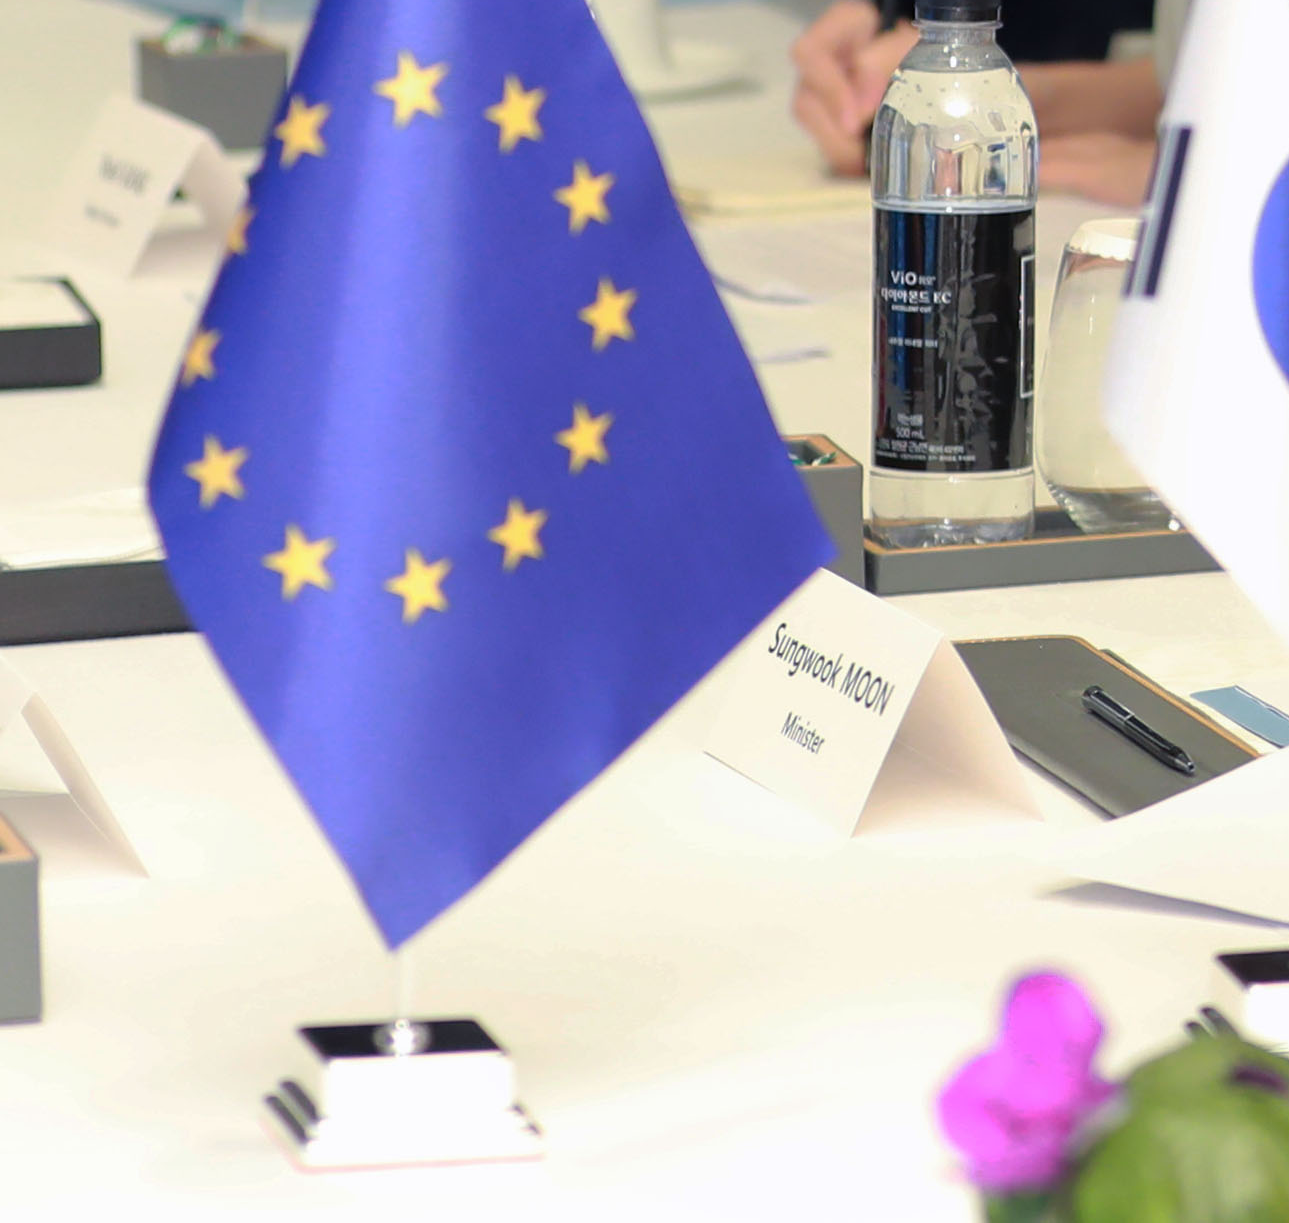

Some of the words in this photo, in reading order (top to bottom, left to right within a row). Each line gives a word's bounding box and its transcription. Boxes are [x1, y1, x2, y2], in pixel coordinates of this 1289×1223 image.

[891, 270, 917, 286] ViO
[881, 287, 930, 305] 다이아몬드
[933, 290, 952, 306] EC
[768, 623, 844, 688] Sungwook
[839, 662, 895, 716] MOON
[781, 712, 825, 754] Minister
